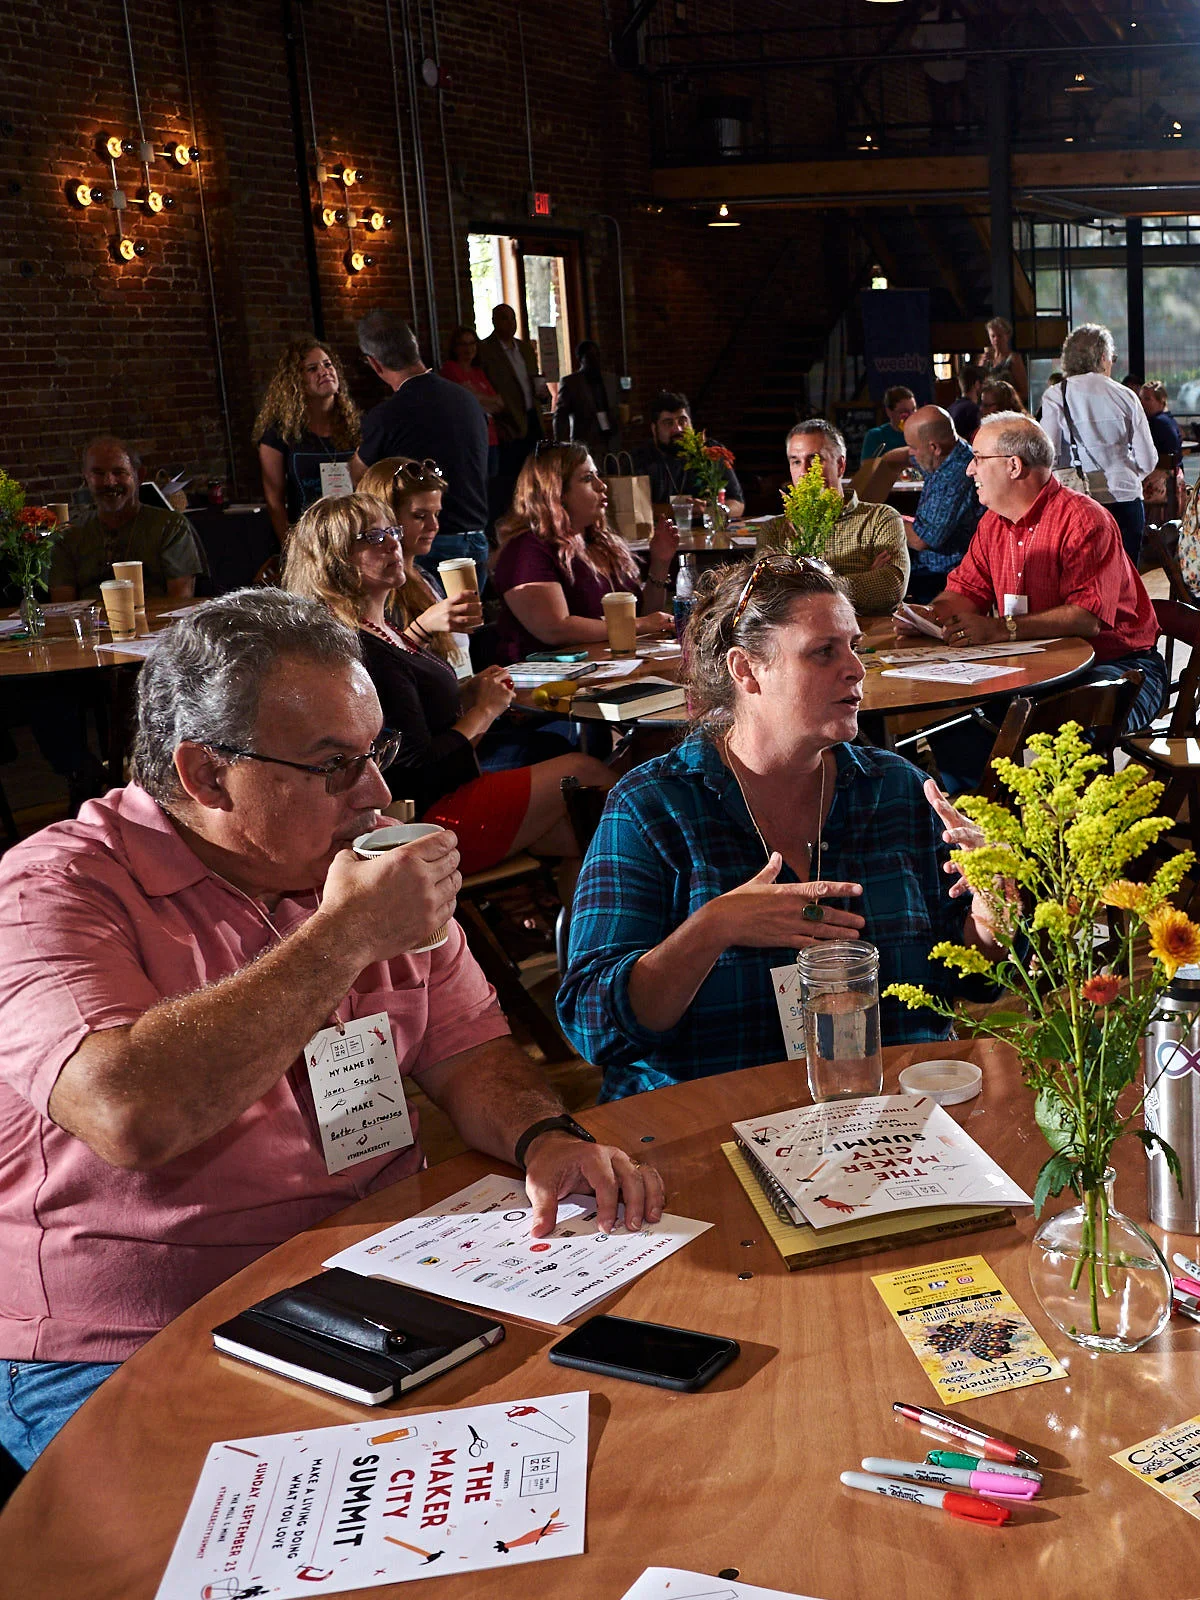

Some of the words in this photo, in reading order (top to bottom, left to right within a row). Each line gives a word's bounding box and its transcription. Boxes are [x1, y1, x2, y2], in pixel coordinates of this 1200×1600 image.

[535, 192, 549, 214] EXIT
[873, 353, 928, 375] weebly
[329, 1068, 340, 1078] MY
[343, 1060, 365, 1073] NAME
[367, 1057, 375, 1065] IS
[345, 1108, 349, 1116] I
[351, 1100, 374, 1113] MAKE
[840, 1125, 874, 1134] LIVING
[869, 1118, 900, 1126] WHAT
[347, 1141, 391, 1160] #THEMAKERCITY
[817, 1133, 926, 1156] SUMMIT
[852, 1146, 912, 1160] CITY
[840, 1155, 940, 1174] MAKER
[874, 1168, 928, 1181] THE
[657, 1238, 673, 1248] THE
[625, 1248, 655, 1267] MAKER
[605, 1267, 625, 1279] CITY
[571, 1279, 604, 1297] SUMMIT
[983, 1296, 1003, 1306] JULY
[921, 1312, 946, 1323] DATES
[948, 1308, 973, 1318] SHOW
[974, 1361, 1018, 1377] Fair
[947, 1365, 1052, 1394] Craftsmen's
[307, 1458, 323, 1484] MAKE
[247, 1462, 269, 1501] SUNDAY,
[286, 1473, 303, 1500] WHAT
[420, 1449, 457, 1530] MAKER
[464, 1461, 495, 1504] THE
[333, 1454, 380, 1546] SUMMIT
[382, 1469, 415, 1518] CITY
[890, 1487, 925, 1505] Sharpie
[225, 1506, 235, 1520] MILL
[280, 1504, 295, 1523] YOU
[296, 1497, 314, 1527] LIVING
[217, 1528, 228, 1543] MINE
[229, 1504, 256, 1558] SEPTEMBER
[272, 1526, 288, 1550] LOVE
[287, 1530, 305, 1559] DOING
